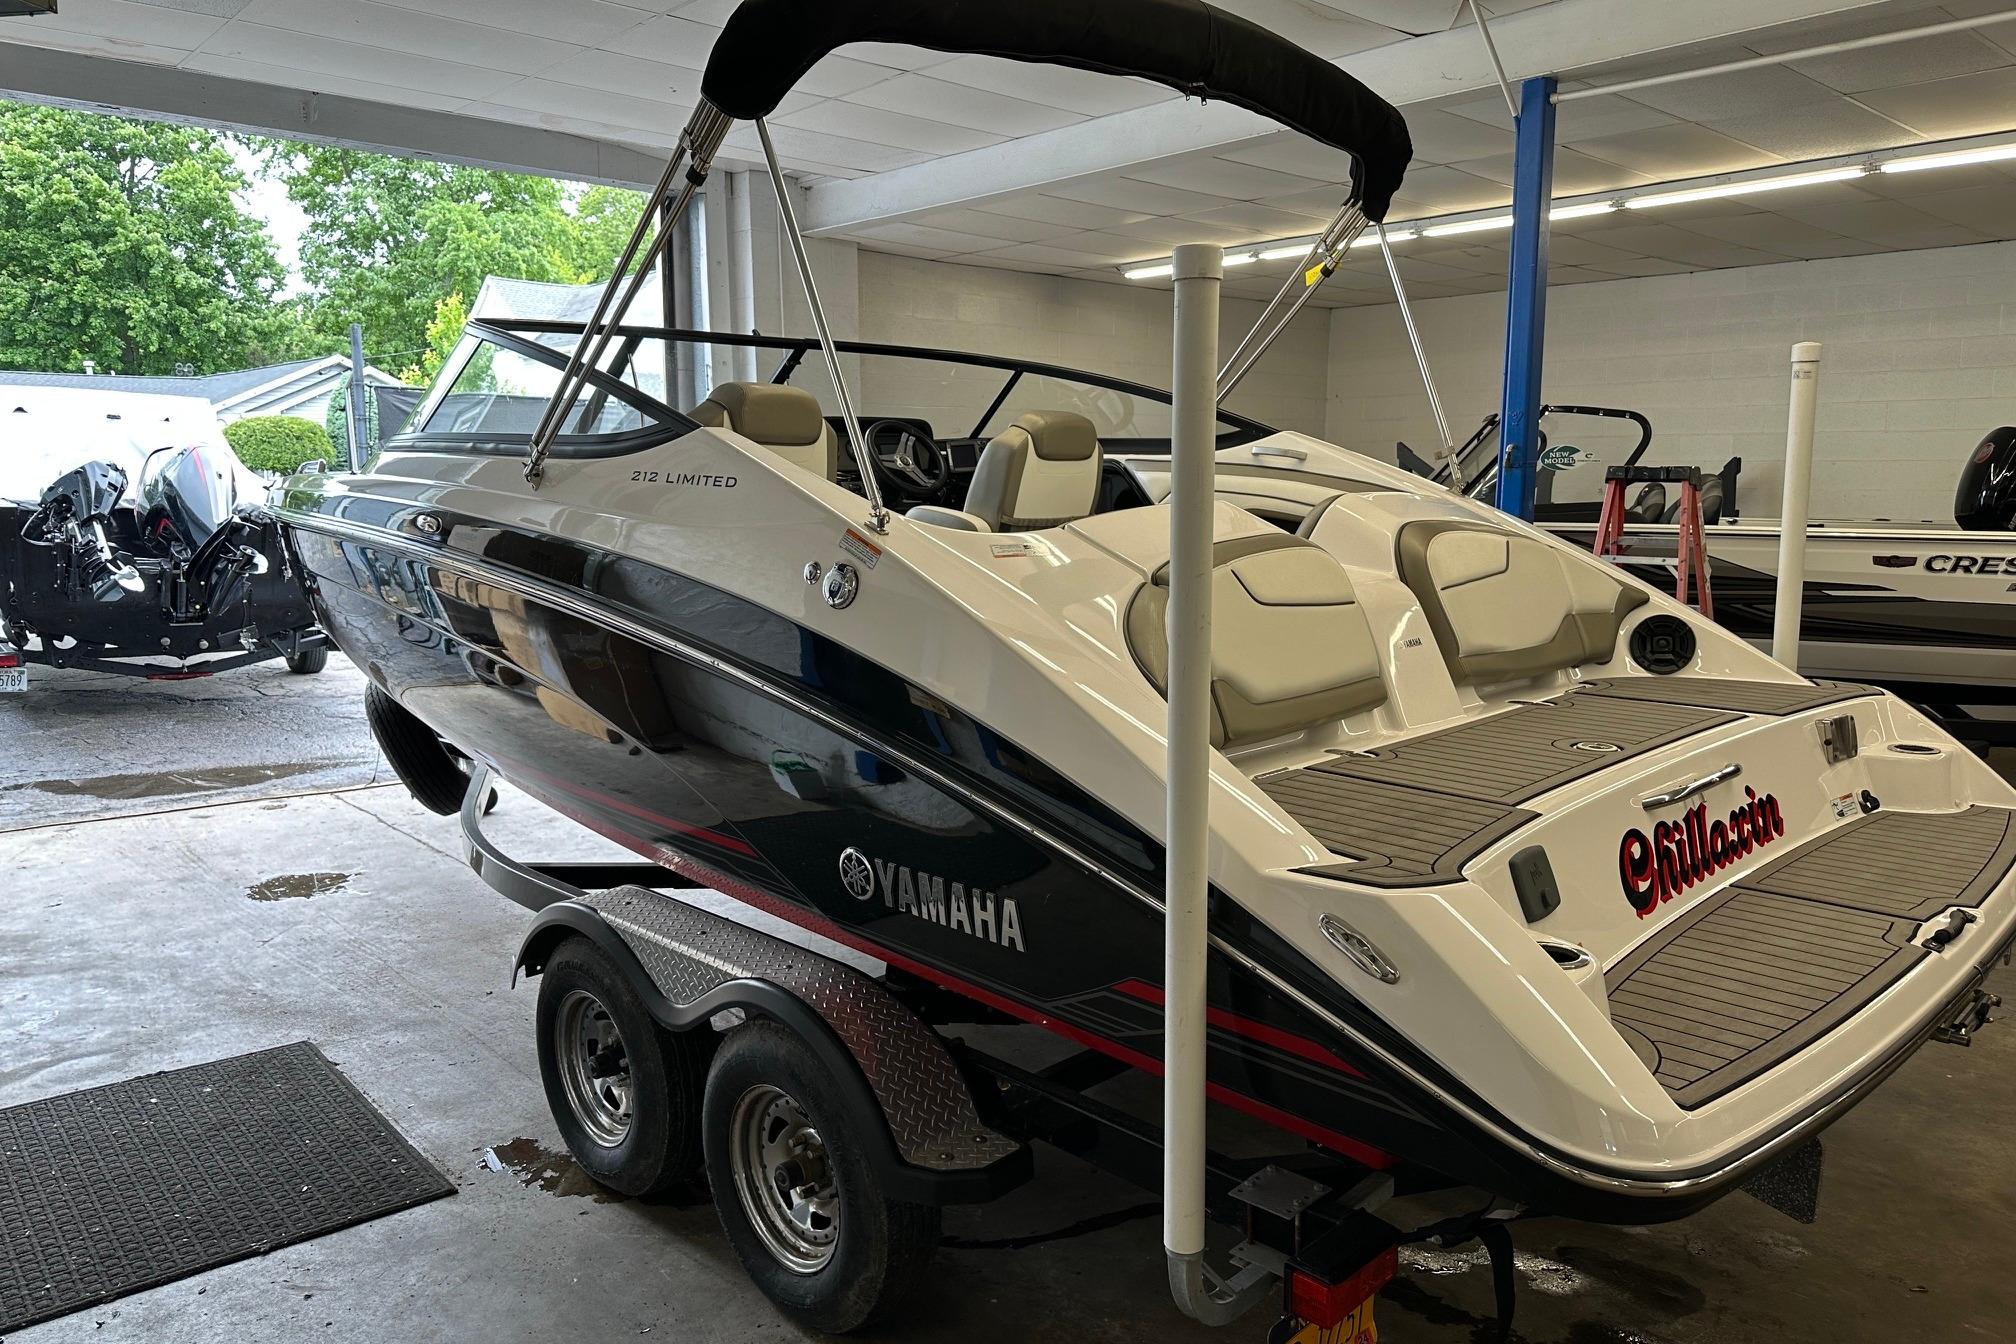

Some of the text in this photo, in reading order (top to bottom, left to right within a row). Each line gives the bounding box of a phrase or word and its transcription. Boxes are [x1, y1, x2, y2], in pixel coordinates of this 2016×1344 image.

[630, 470, 738, 488] 212 LIMITED
[1618, 784, 1785, 920] Chillaxin
[874, 857, 1027, 953] YAMAHA
